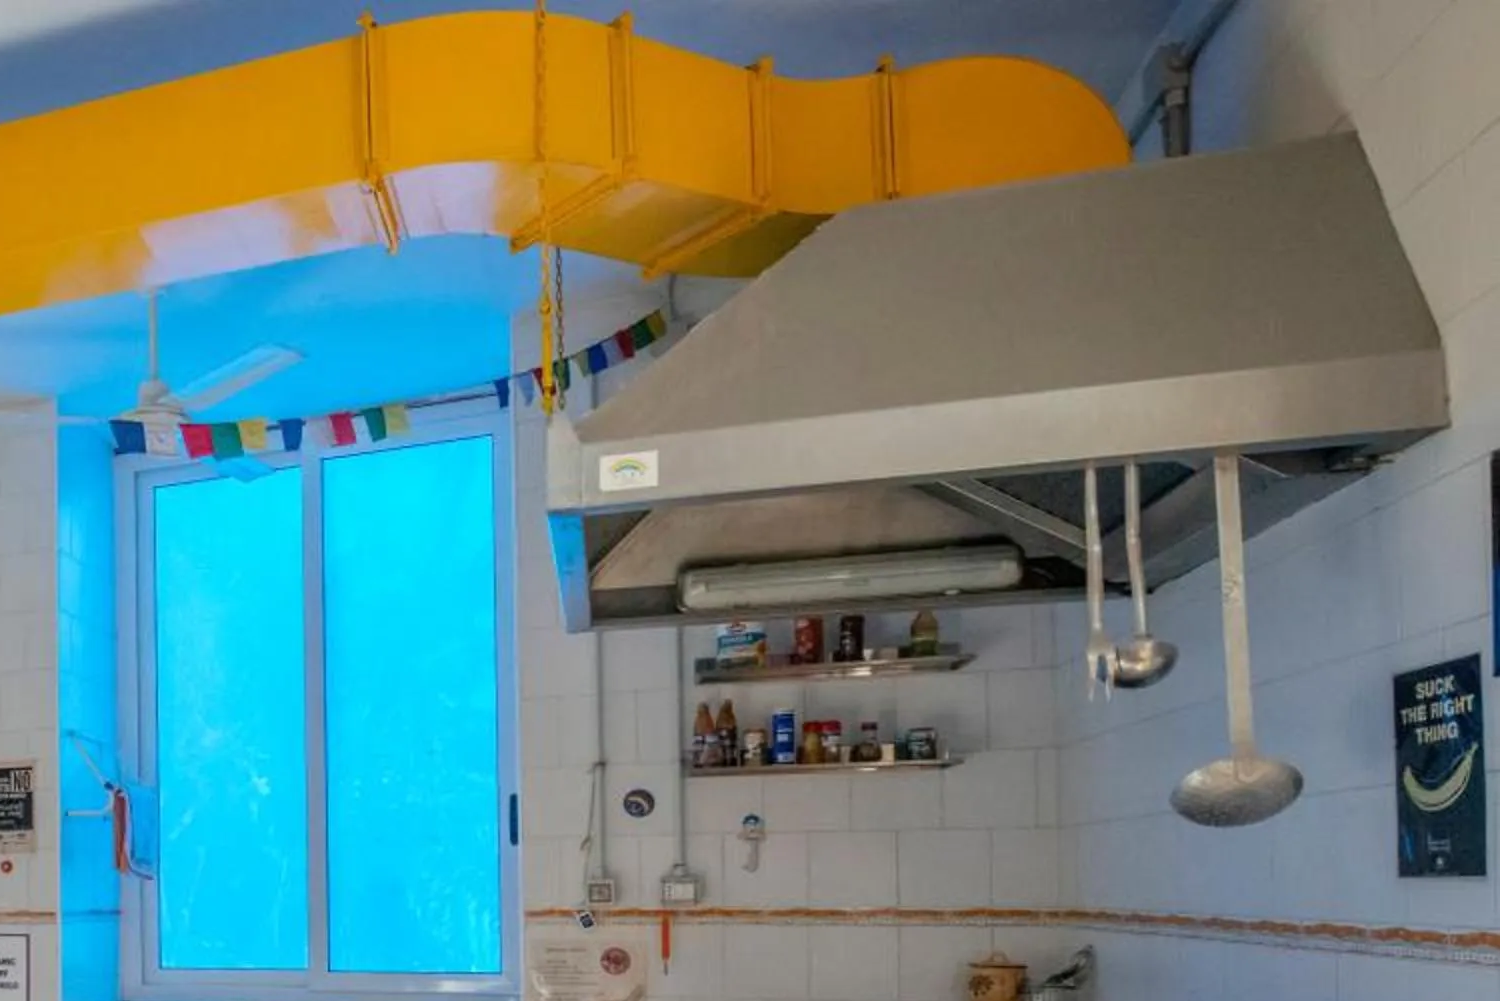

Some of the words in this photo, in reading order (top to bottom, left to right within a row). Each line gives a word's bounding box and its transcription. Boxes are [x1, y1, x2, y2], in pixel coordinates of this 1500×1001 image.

[1415, 674, 1456, 701] SUCK
[1400, 704, 1428, 726] THE
[1430, 693, 1476, 720] RIGHT
[1415, 720, 1459, 745] THING
